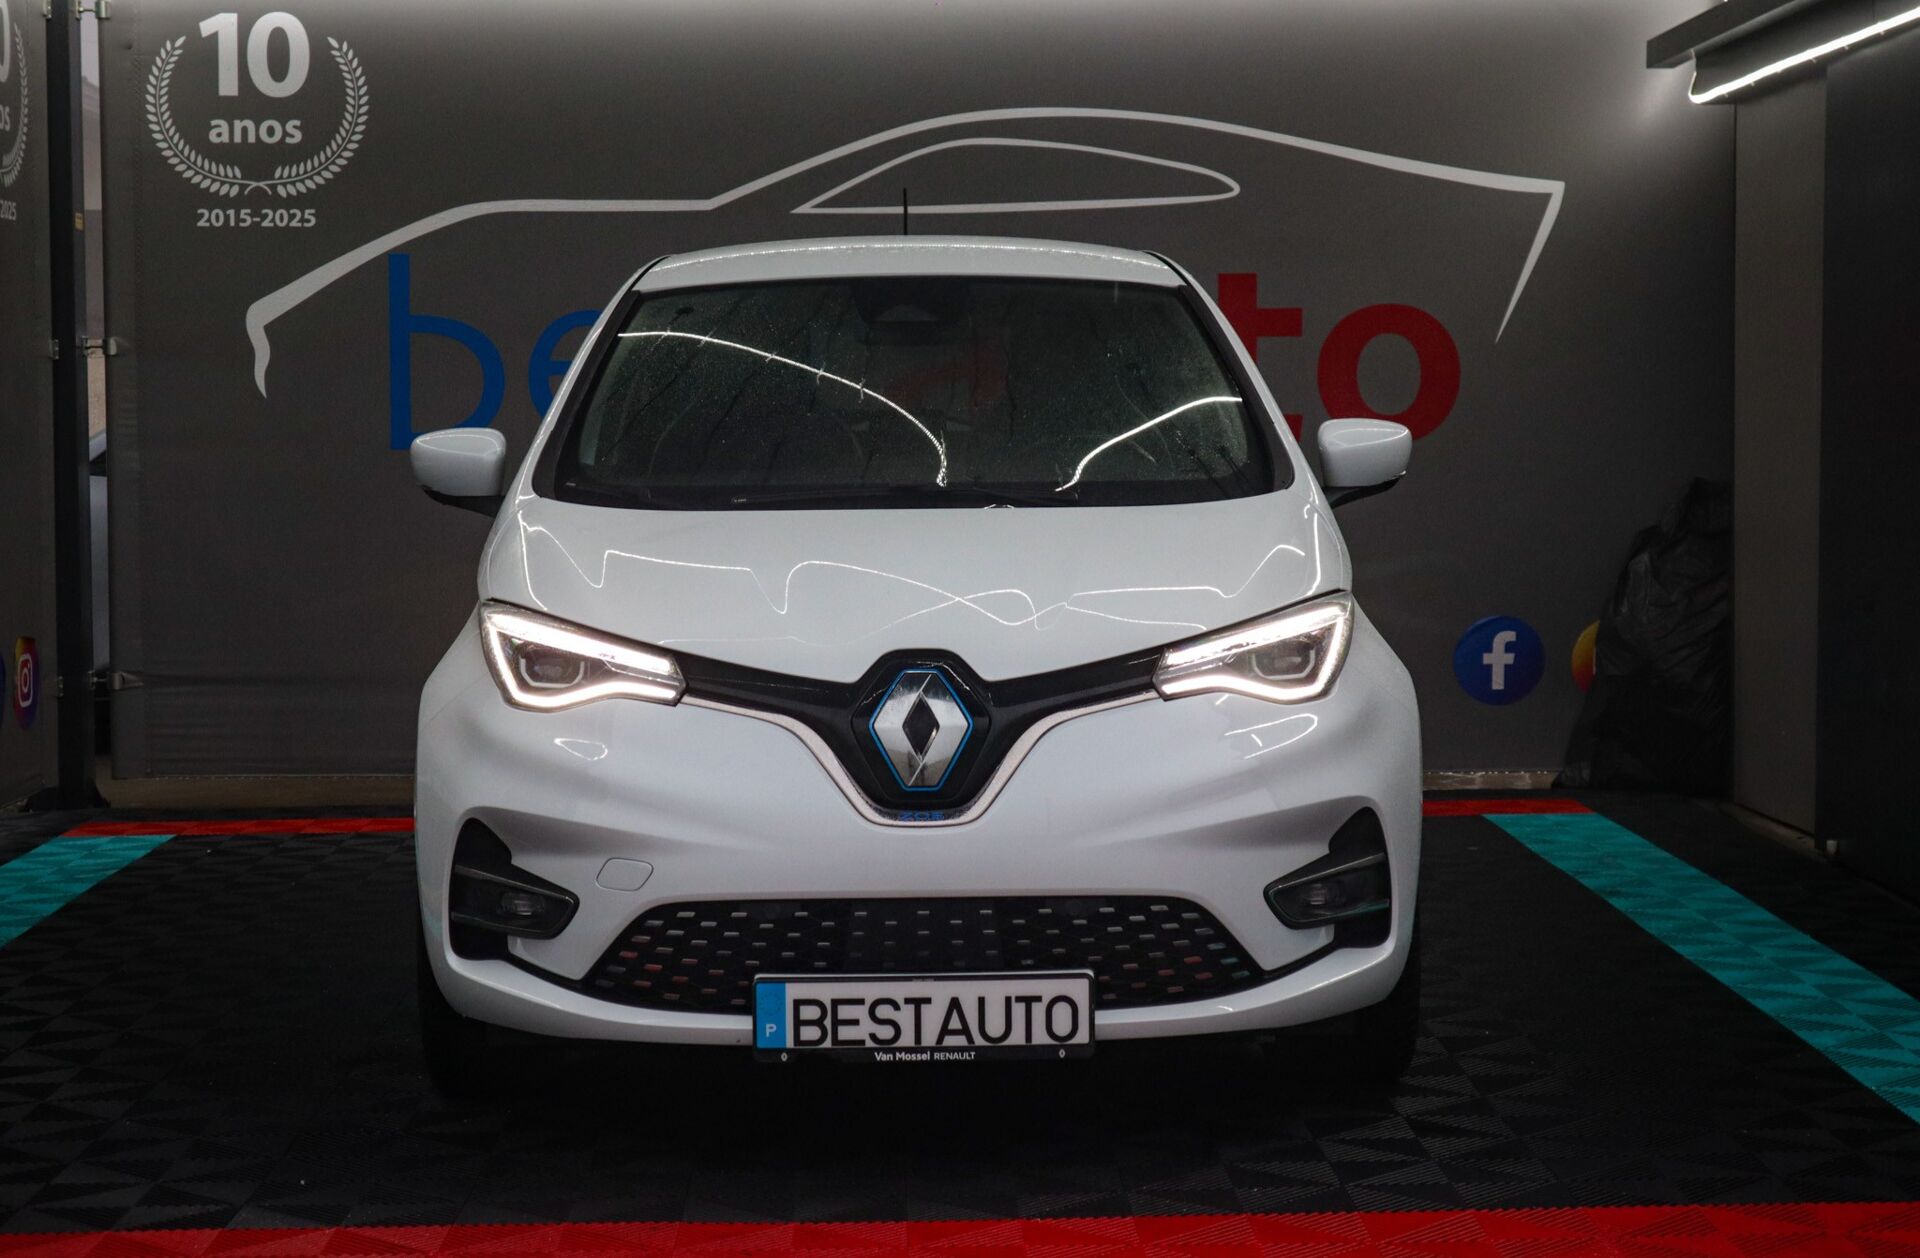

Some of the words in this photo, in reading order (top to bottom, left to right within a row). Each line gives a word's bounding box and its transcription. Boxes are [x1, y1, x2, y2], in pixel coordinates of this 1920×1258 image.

[199, 11, 310, 98] 10
[208, 118, 303, 144] anos
[196, 208, 316, 227] 2015-2025
[766, 1023, 777, 1037] P
[792, 995, 1079, 1048] BESTAUTO
[874, 1052, 893, 1061] Van
[896, 1051, 930, 1061] Mossel
[934, 1052, 976, 1060] RENAULT
